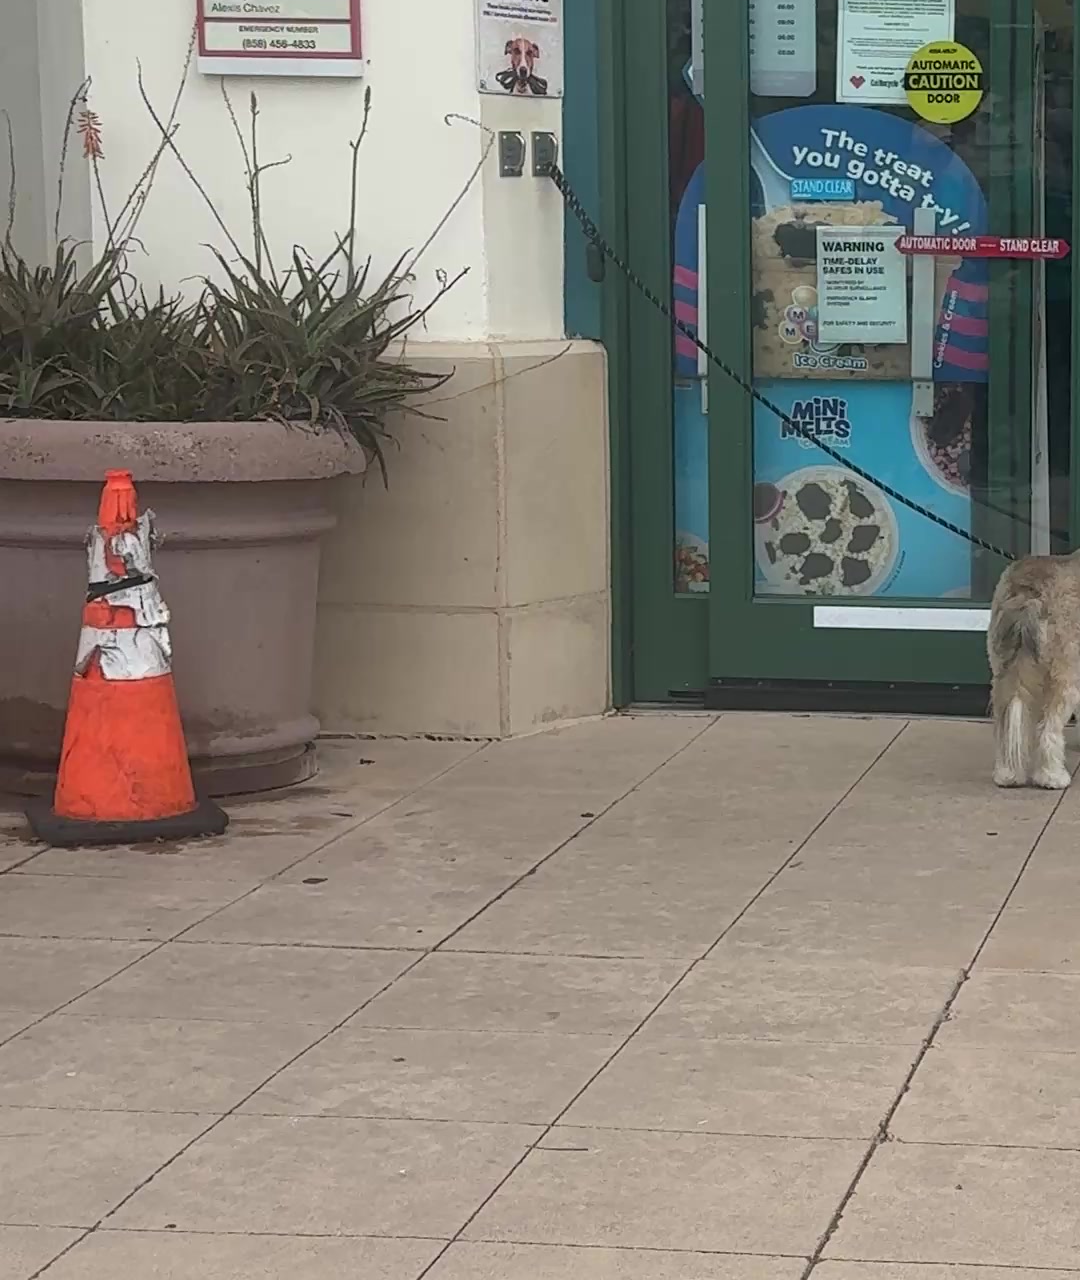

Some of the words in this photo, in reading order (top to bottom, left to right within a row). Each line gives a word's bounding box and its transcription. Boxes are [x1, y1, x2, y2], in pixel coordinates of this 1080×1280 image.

[211, 3, 241, 12] Alexis
[238, 25, 284, 33] EMERGENCY
[912, 60, 976, 70] AUTOMATIC
[908, 75, 978, 89] CAUTION
[928, 94, 960, 104] DOOR
[820, 128, 868, 157] The
[874, 149, 934, 188] treat
[792, 180, 822, 193] STAND
[824, 180, 852, 193] CLEAR
[792, 146, 840, 168] you
[846, 160, 916, 202] gotta
[921, 194, 971, 235] try!
[822, 242, 884, 252] WARNING
[900, 237, 950, 250] AUTOMATIC
[952, 238, 976, 251] DOOR
[1000, 239, 1028, 252] STAND
[1030, 240, 1059, 253] CLEAR
[822, 258, 878, 266] TIME-DELAY
[794, 354, 817, 367] Ice
[820, 356, 867, 370] Cream
[782, 417, 850, 438] MELTS
